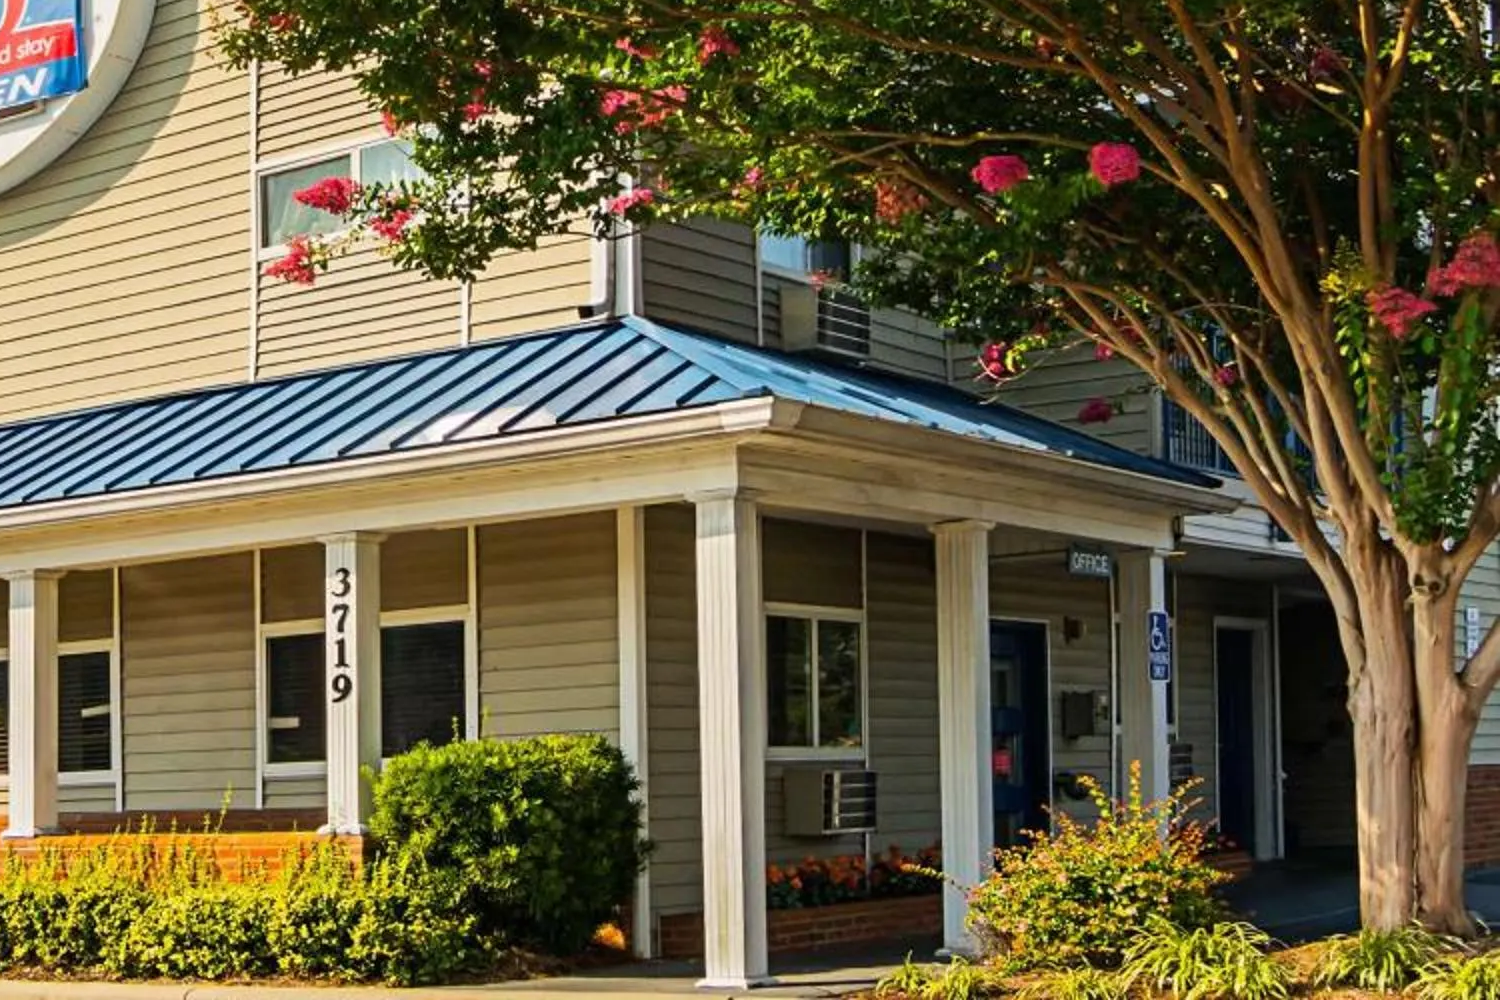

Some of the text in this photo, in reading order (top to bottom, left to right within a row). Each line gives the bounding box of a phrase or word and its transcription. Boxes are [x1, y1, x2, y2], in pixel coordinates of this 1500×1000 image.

[16, 35, 57, 59] stay
[1073, 551, 1110, 573] OFFICE
[331, 567, 352, 703] 3719
